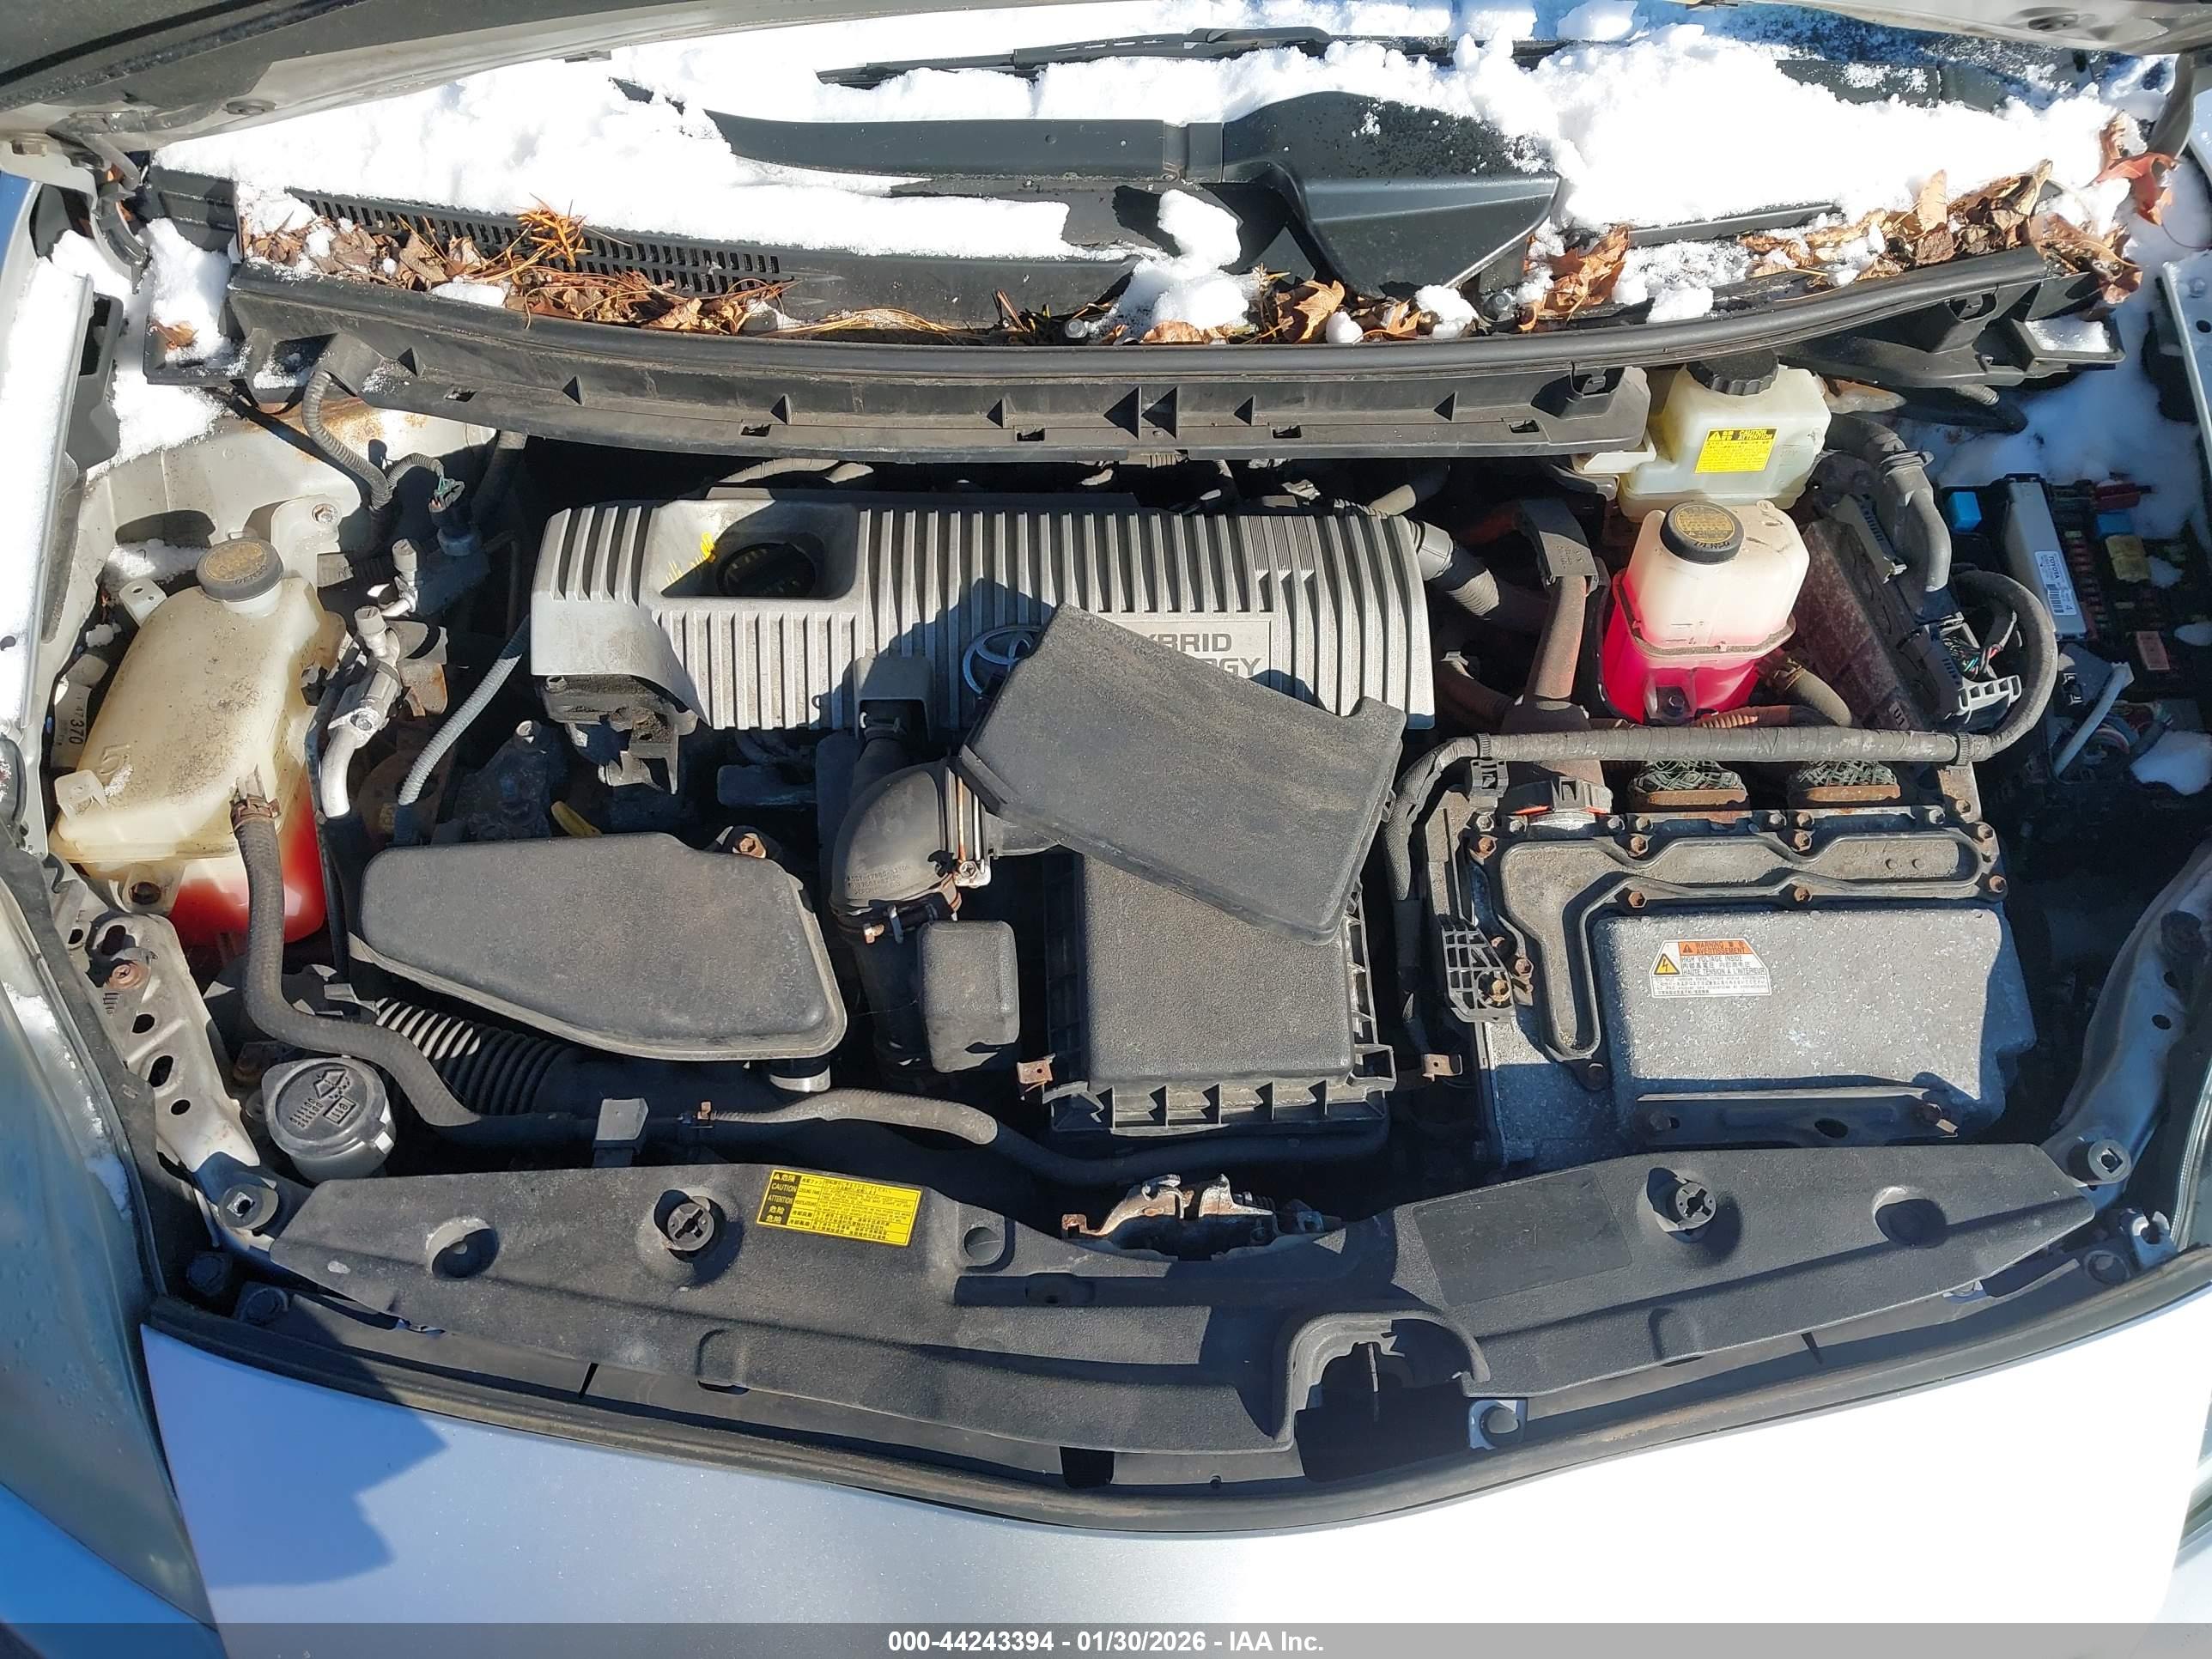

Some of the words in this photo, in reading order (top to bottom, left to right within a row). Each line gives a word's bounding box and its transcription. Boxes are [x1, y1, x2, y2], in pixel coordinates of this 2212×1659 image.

[2048, 556, 2061, 579] TOYOTA
[771, 1182, 798, 1193] CAUTION
[767, 1194, 794, 1204] ATTENTION
